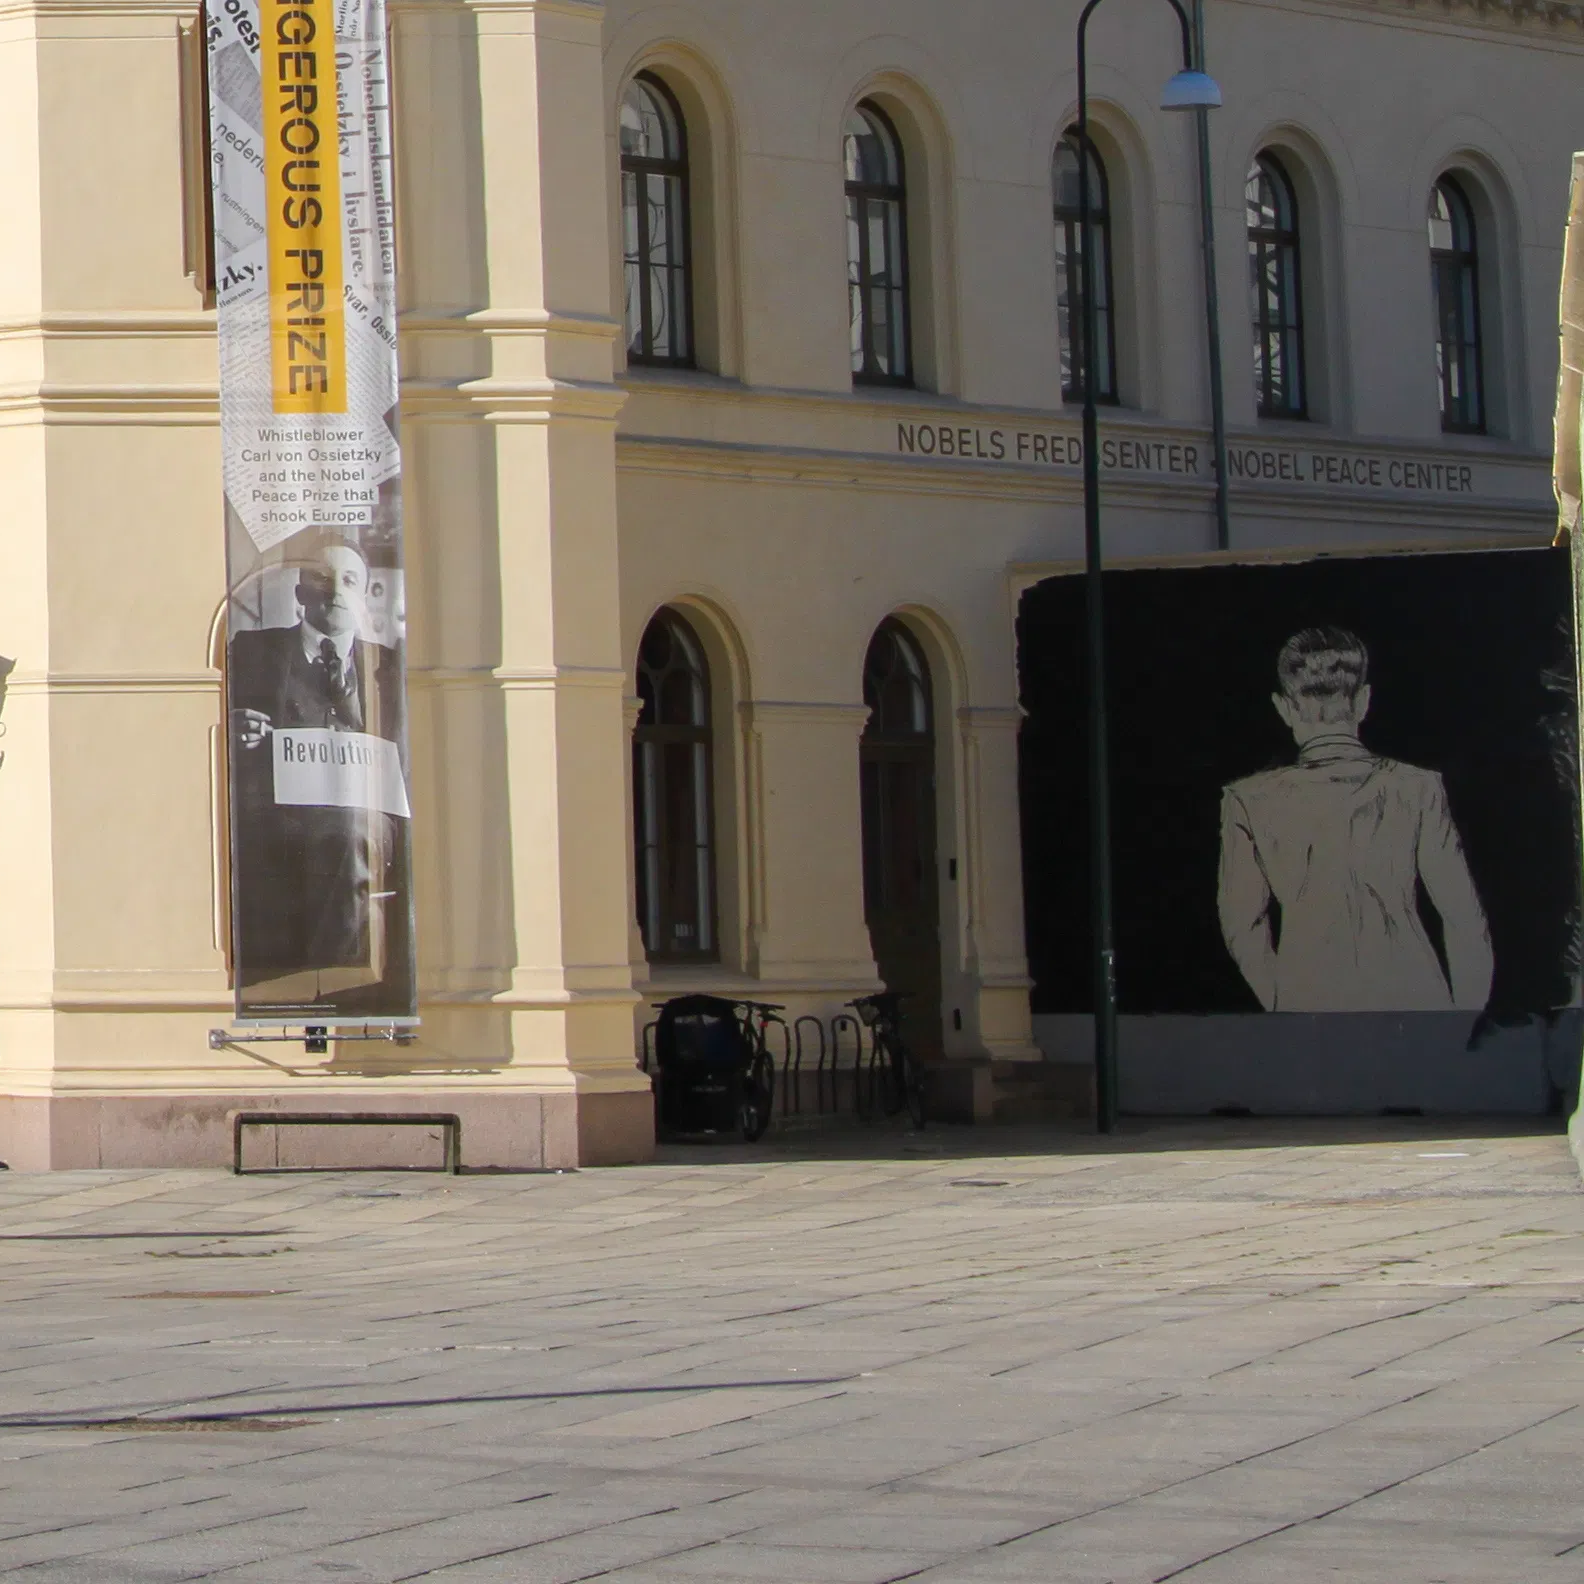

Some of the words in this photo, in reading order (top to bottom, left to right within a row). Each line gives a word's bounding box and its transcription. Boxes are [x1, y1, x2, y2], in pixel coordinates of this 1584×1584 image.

[335, 52, 361, 158] Ossietzky
[344, 191, 373, 278] livsfare.
[285, 249, 328, 396] PRIZE
[258, 429, 363, 442] Whistleblower
[241, 449, 271, 462] Carl
[276, 452, 302, 462] von
[308, 448, 381, 463] Ossietzky
[897, 423, 1006, 460] NOBELS
[1016, 433, 1199, 474] FREDSENTER
[1228, 448, 1305, 482] NOBEL
[1312, 455, 1382, 487] PEACE
[1388, 461, 1474, 493] CENTER
[259, 470, 285, 482] and
[292, 470, 316, 482] the
[321, 469, 365, 481] Nobel
[252, 490, 297, 502] Peace
[303, 490, 339, 502] Prize
[344, 490, 374, 501] that
[261, 510, 307, 522] shook
[312, 510, 366, 524] Europe
